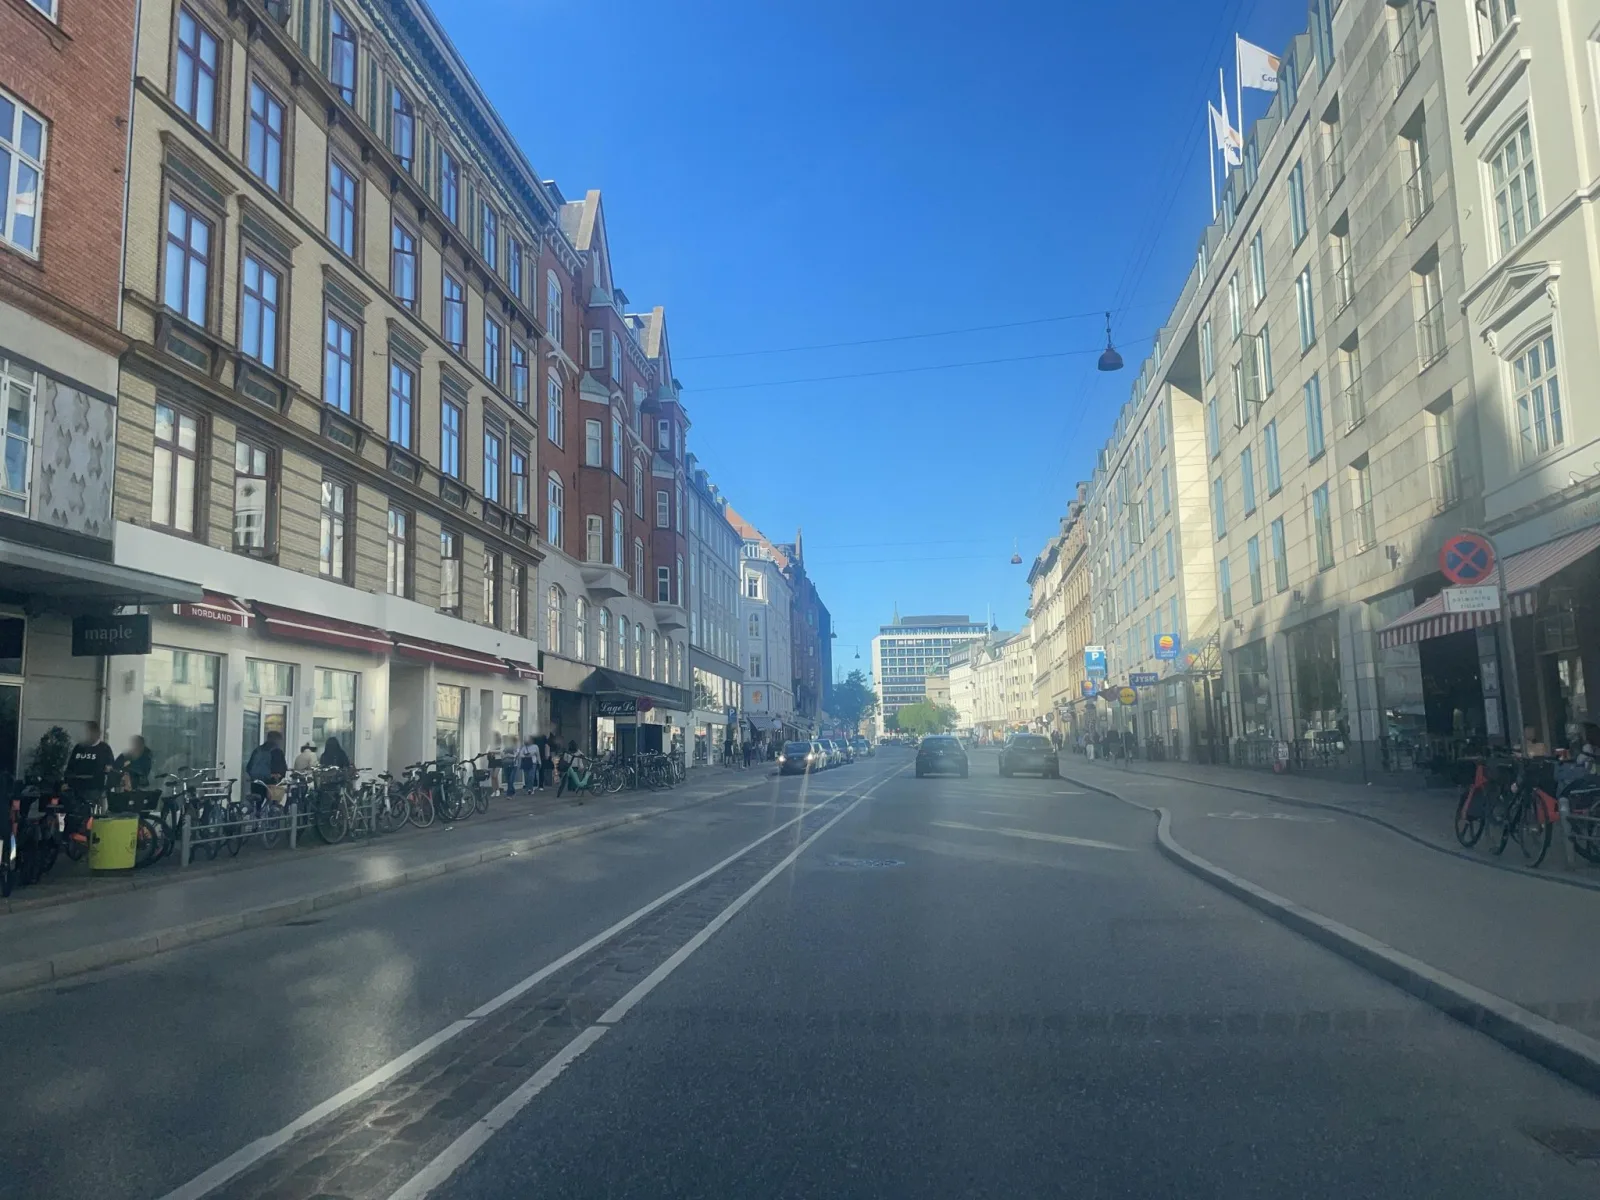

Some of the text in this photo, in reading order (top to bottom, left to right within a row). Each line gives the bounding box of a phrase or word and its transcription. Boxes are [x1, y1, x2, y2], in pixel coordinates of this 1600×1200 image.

[191, 607, 232, 622] NORDLAND
[84, 624, 133, 643] maple
[1091, 652, 1100, 661] P
[1134, 675, 1156, 683] JYSK
